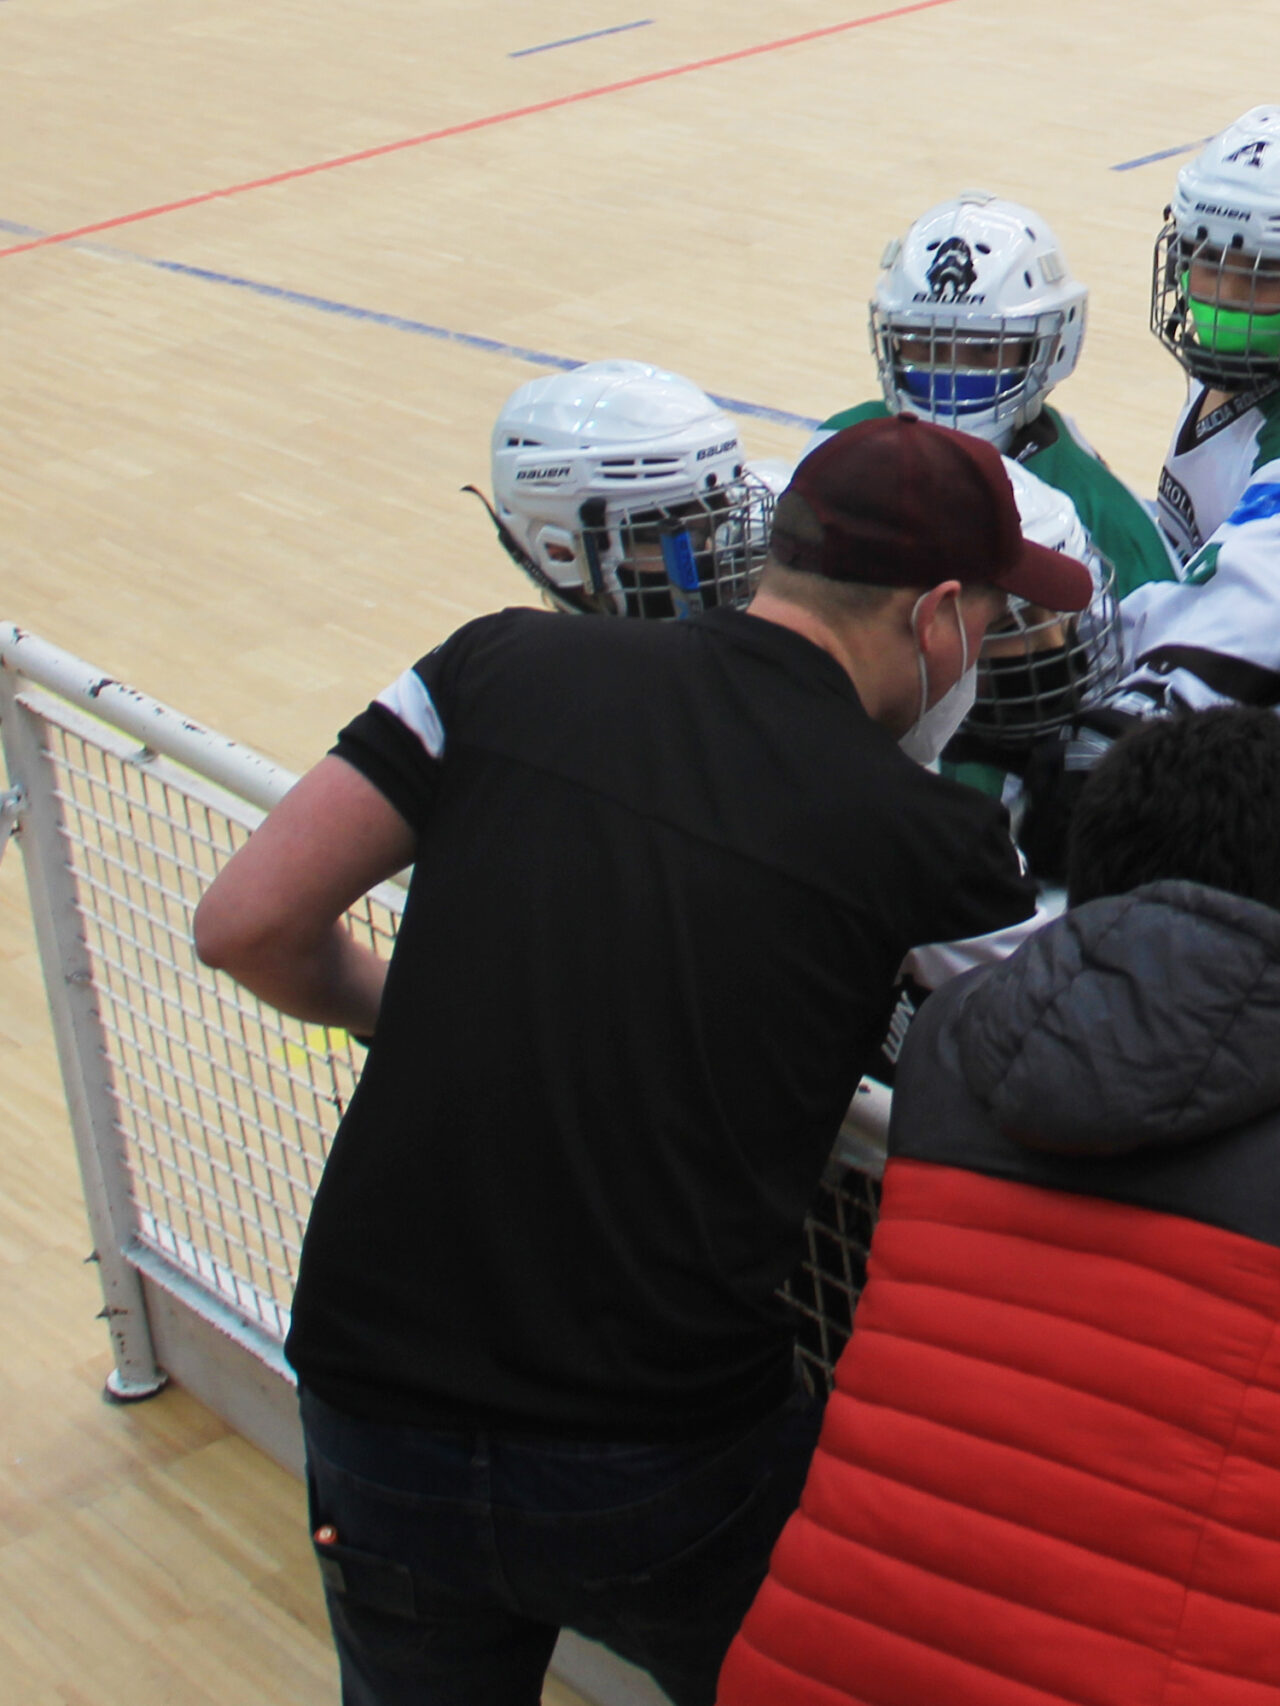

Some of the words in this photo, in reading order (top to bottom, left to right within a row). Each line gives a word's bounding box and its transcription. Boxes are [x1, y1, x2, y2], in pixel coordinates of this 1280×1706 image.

[1194, 203, 1251, 222] BAUER
[912, 293, 986, 305] BAUER
[516, 467, 571, 481] BAUER
